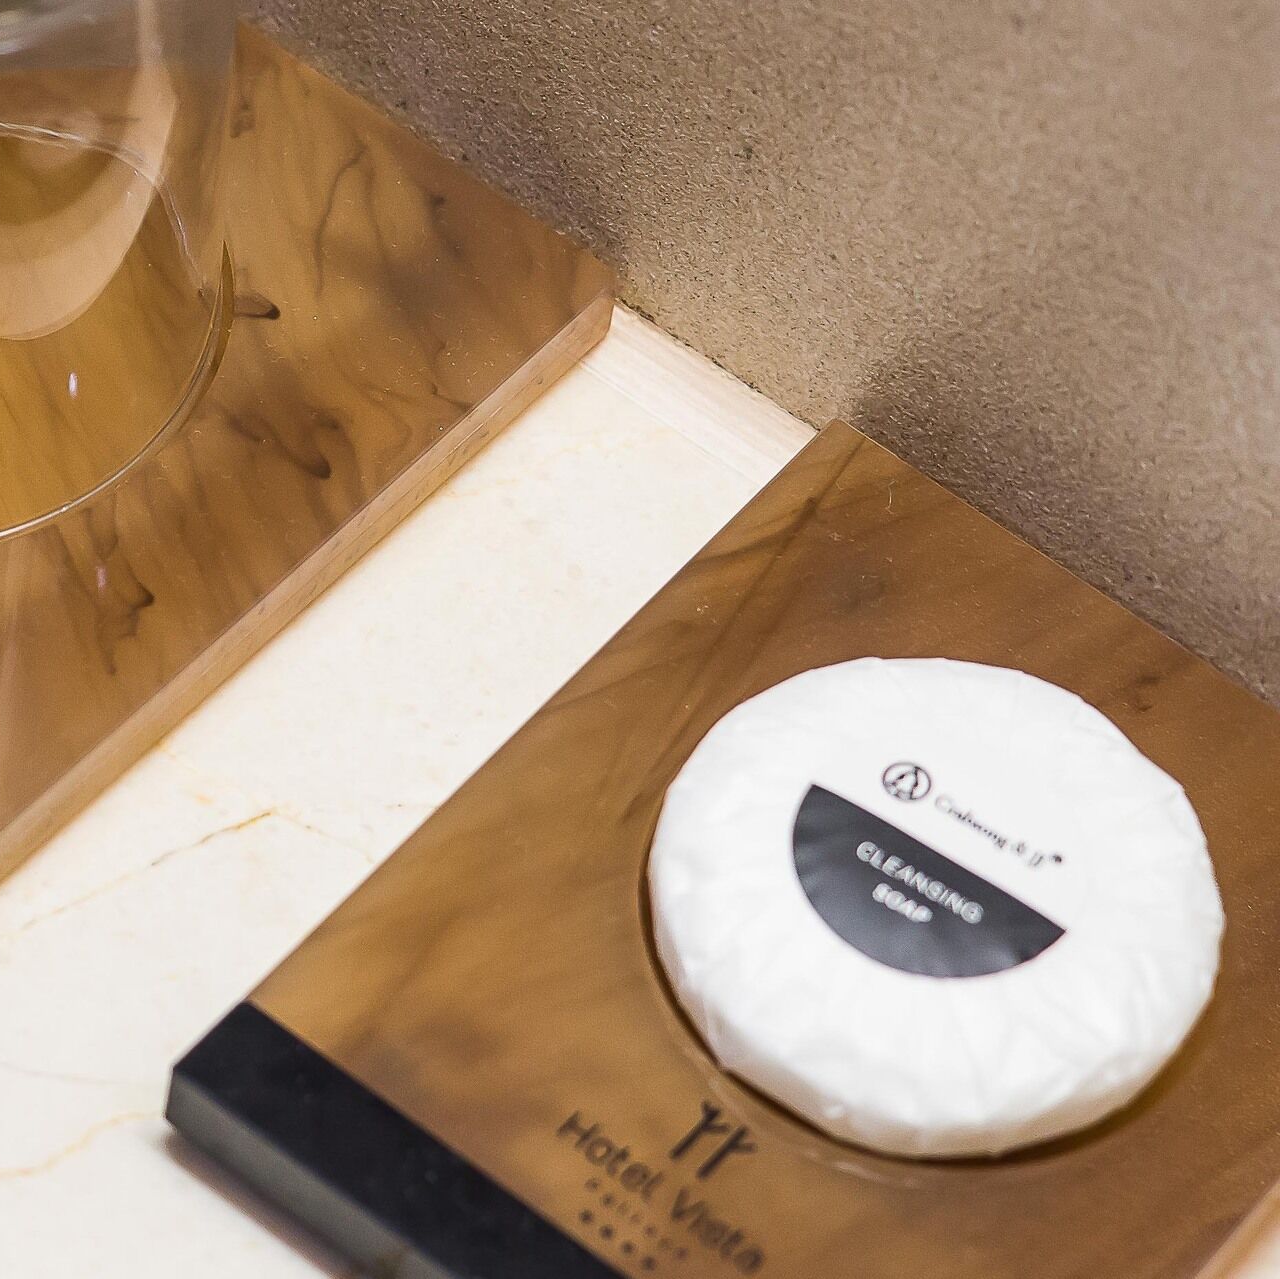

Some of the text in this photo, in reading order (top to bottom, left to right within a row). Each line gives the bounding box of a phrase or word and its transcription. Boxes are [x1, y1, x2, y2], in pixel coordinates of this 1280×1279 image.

[856, 840, 985, 925] CLEANSING
[872, 882, 934, 923] SOAP
[555, 1109, 664, 1202] Hotel
